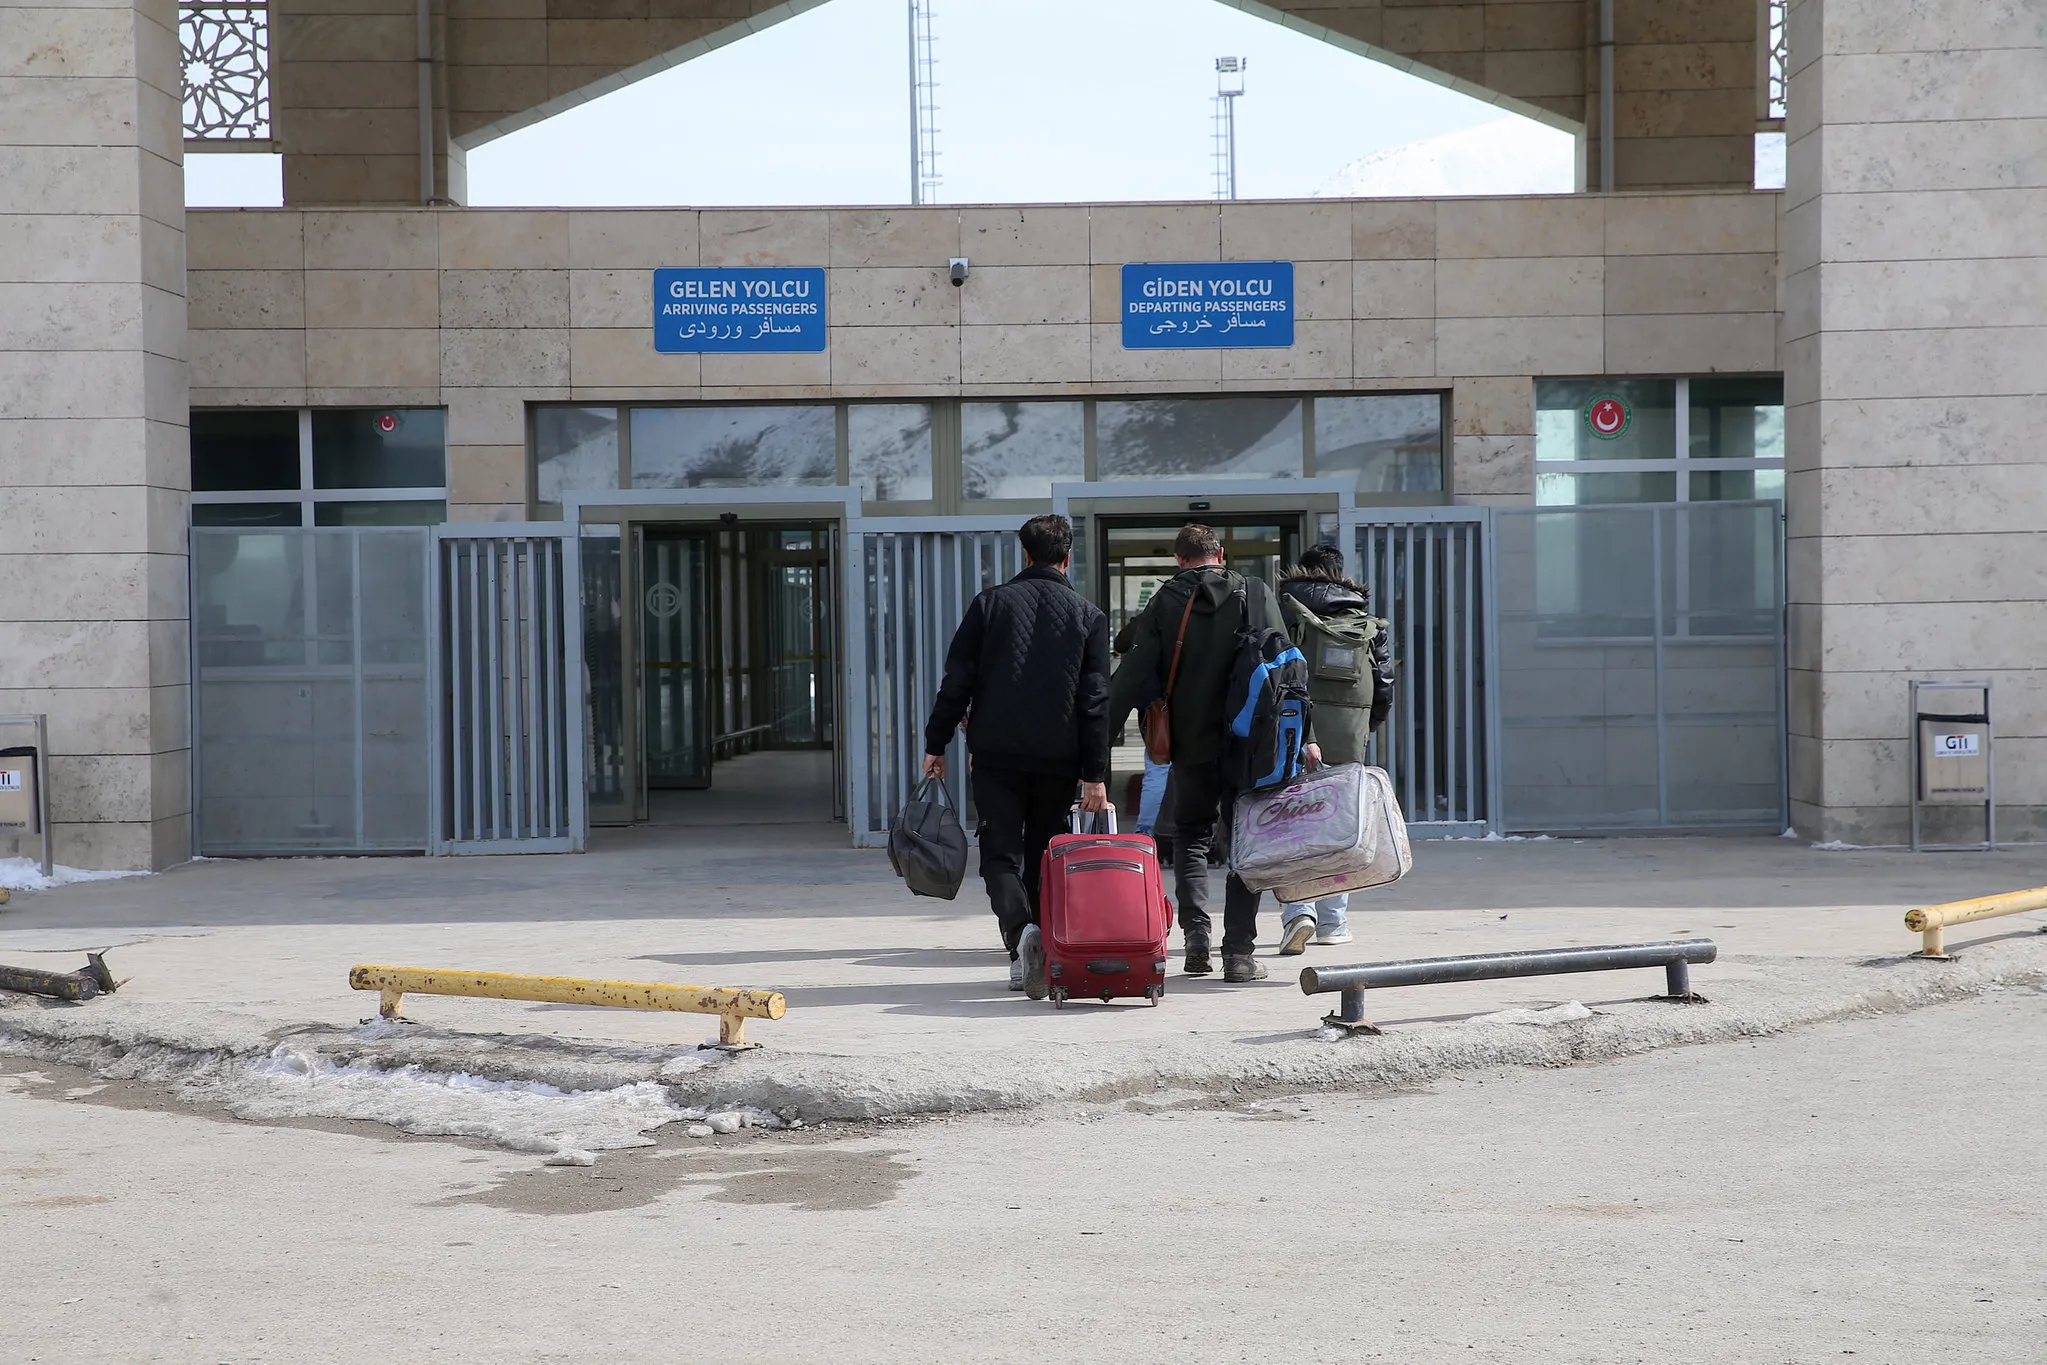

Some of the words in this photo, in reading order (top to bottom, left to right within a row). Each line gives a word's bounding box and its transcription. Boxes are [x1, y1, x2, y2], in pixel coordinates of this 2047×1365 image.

[669, 280, 736, 298] GELEN
[741, 280, 810, 298] YOLCU
[1142, 277, 1202, 297] GİDEN
[1207, 279, 1272, 297] YOLCU
[662, 303, 728, 315] ARRIVING
[731, 303, 818, 315] PASSENGERS
[1129, 301, 1201, 313] DEPARTING
[1204, 300, 1287, 312] PASSENGERS
[749, 316, 801, 339] مسافر
[1219, 312, 1266, 332] مسافر
[1256, 797, 1326, 827] Chica
